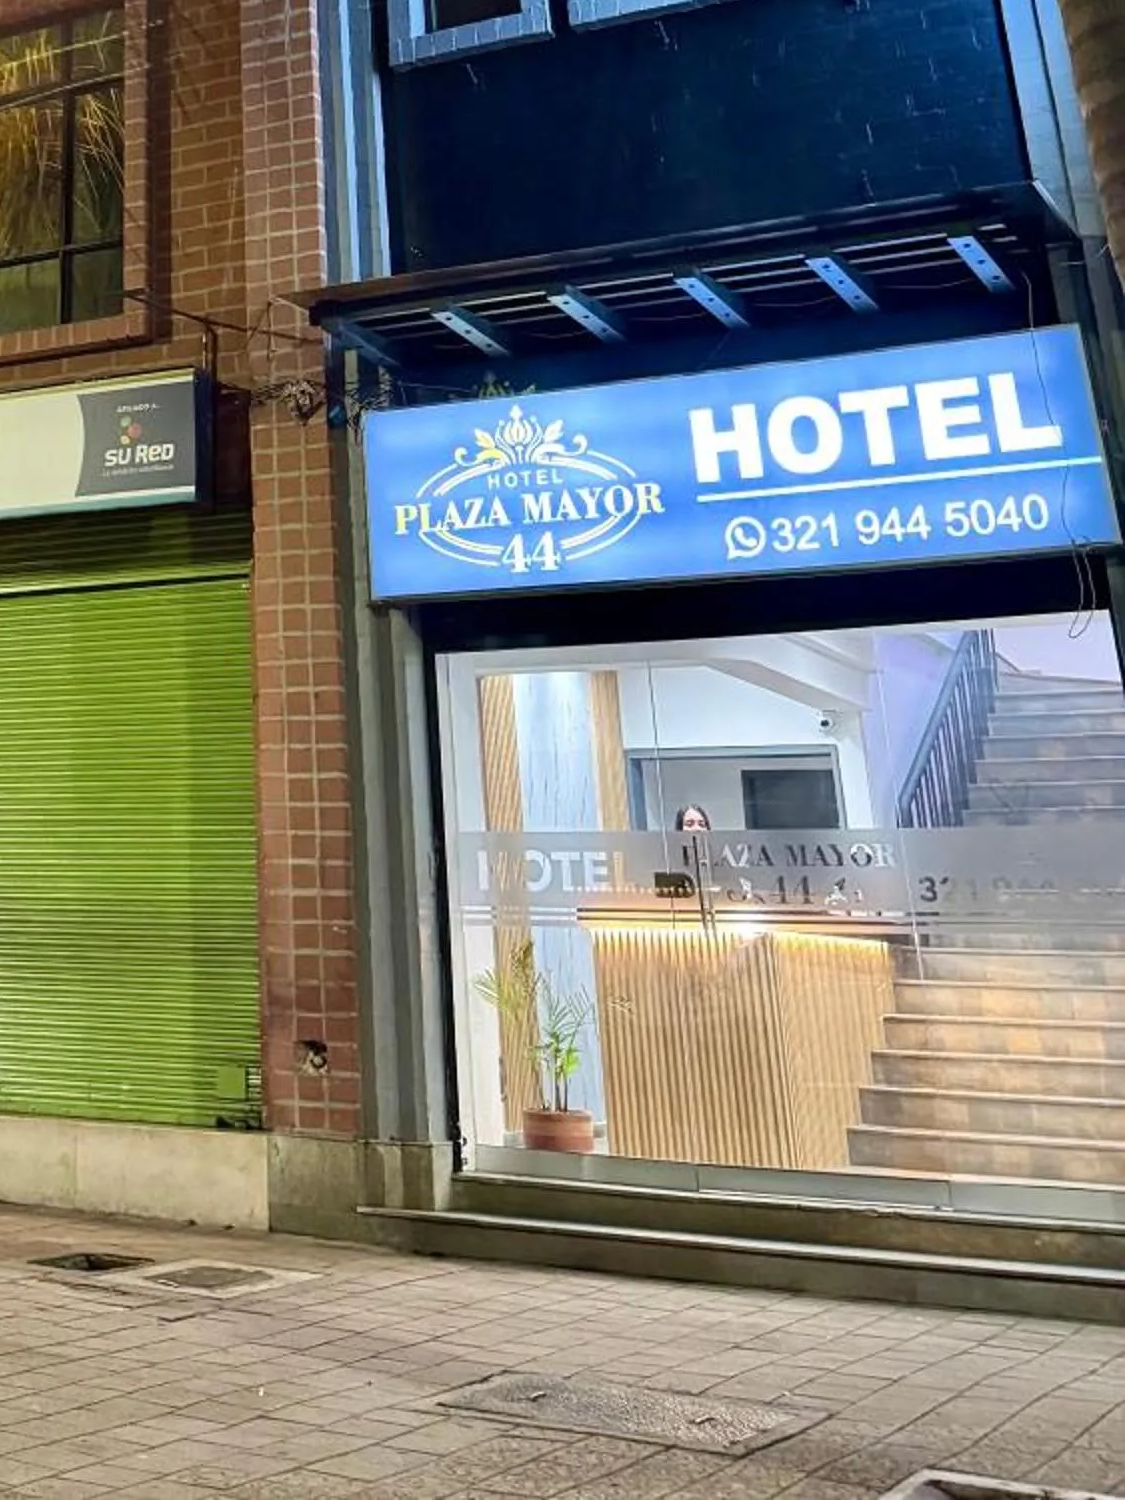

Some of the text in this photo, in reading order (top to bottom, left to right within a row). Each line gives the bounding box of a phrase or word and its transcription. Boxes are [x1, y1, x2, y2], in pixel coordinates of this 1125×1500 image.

[689, 372, 1063, 483] HOTEL
[104, 447, 132, 467] SU
[488, 467, 563, 490] HOTEL
[395, 482, 665, 535] PLAZA MAYOR
[772, 494, 1049, 552] 321 944 5040
[502, 531, 561, 573] 44
[786, 843, 896, 868] MAYOR
